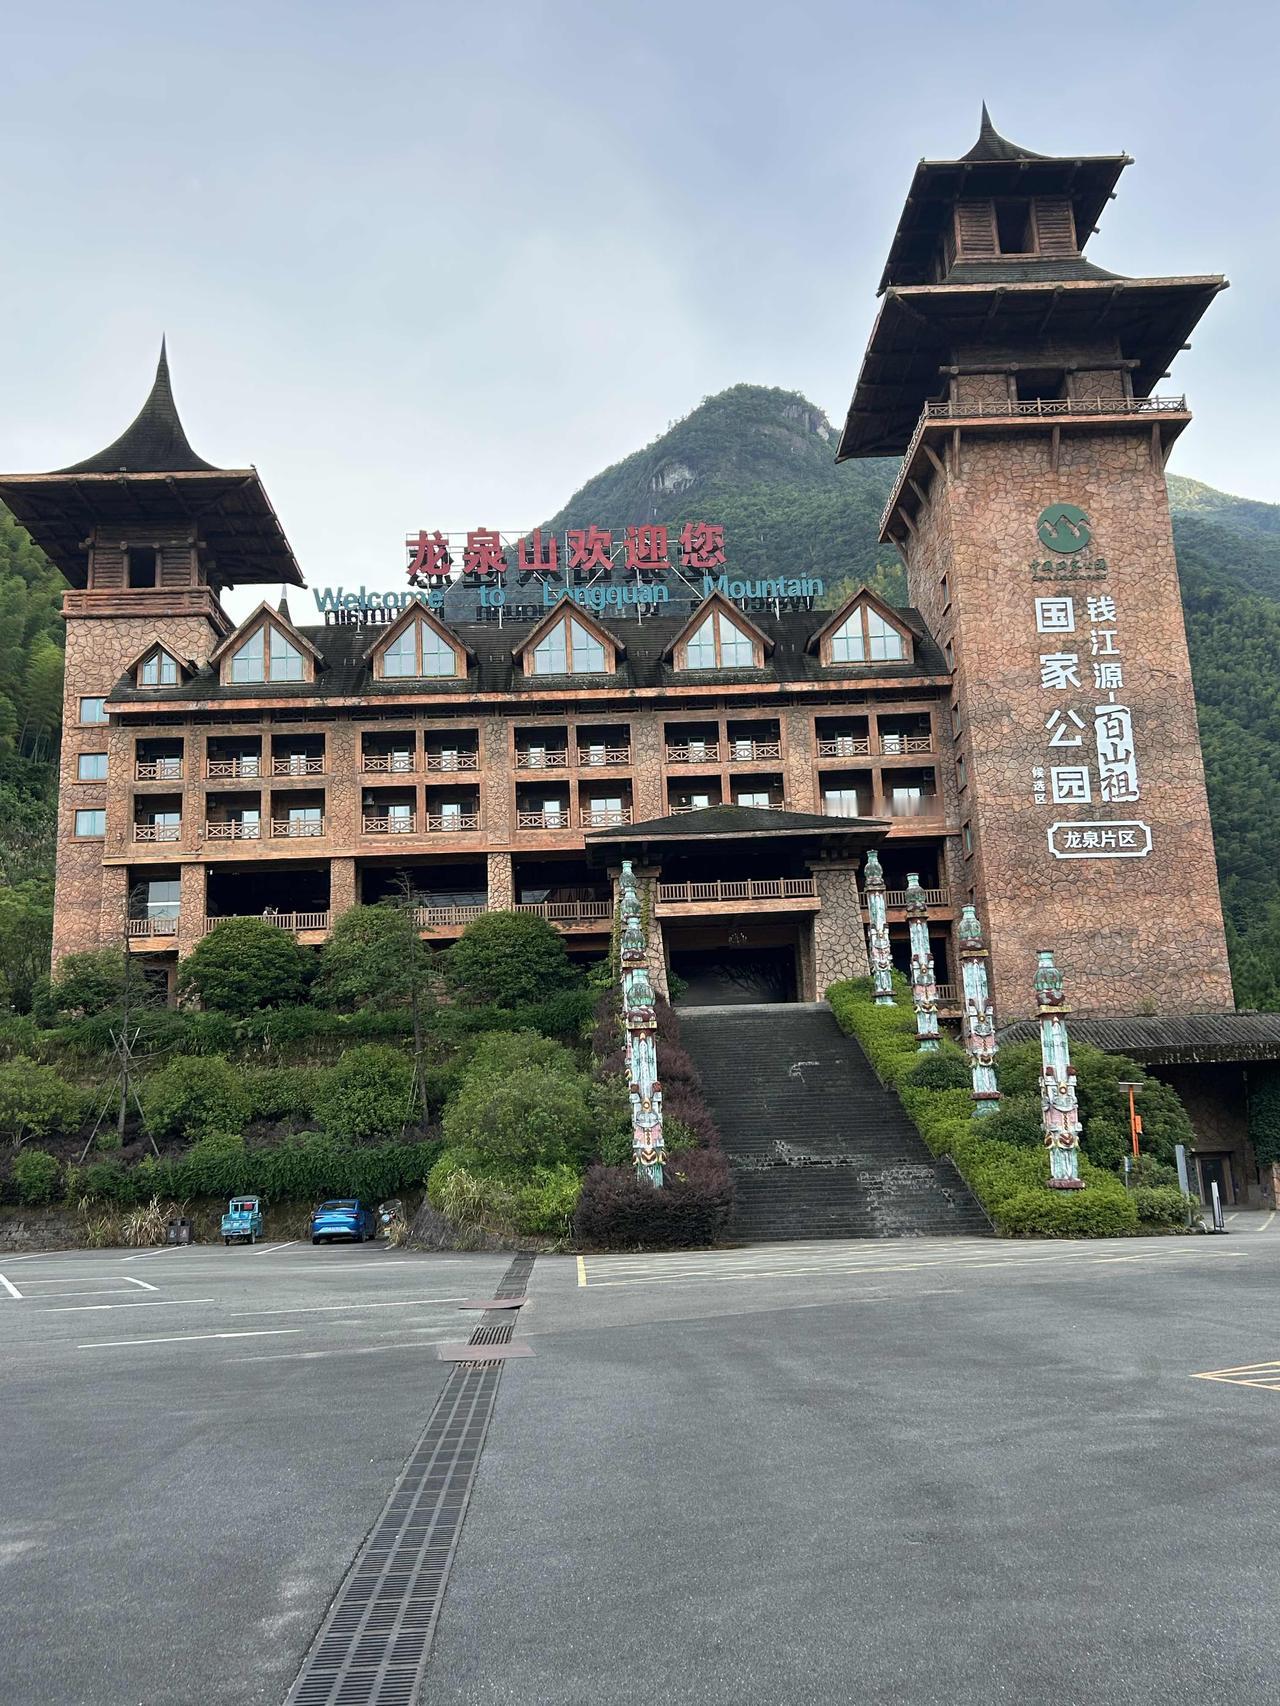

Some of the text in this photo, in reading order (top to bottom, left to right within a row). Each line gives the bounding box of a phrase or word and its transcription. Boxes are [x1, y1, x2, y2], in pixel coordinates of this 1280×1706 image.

[406, 522, 727, 576] 龙泉山欢迎您
[313, 585, 445, 613] Welcome
[478, 585, 506, 607] to
[703, 572, 824, 600] Mountain
[1035, 597, 1092, 804] 国家公园
[1031, 766, 1048, 805] 候选区
[1063, 830, 1137, 849] 龙泉片区
